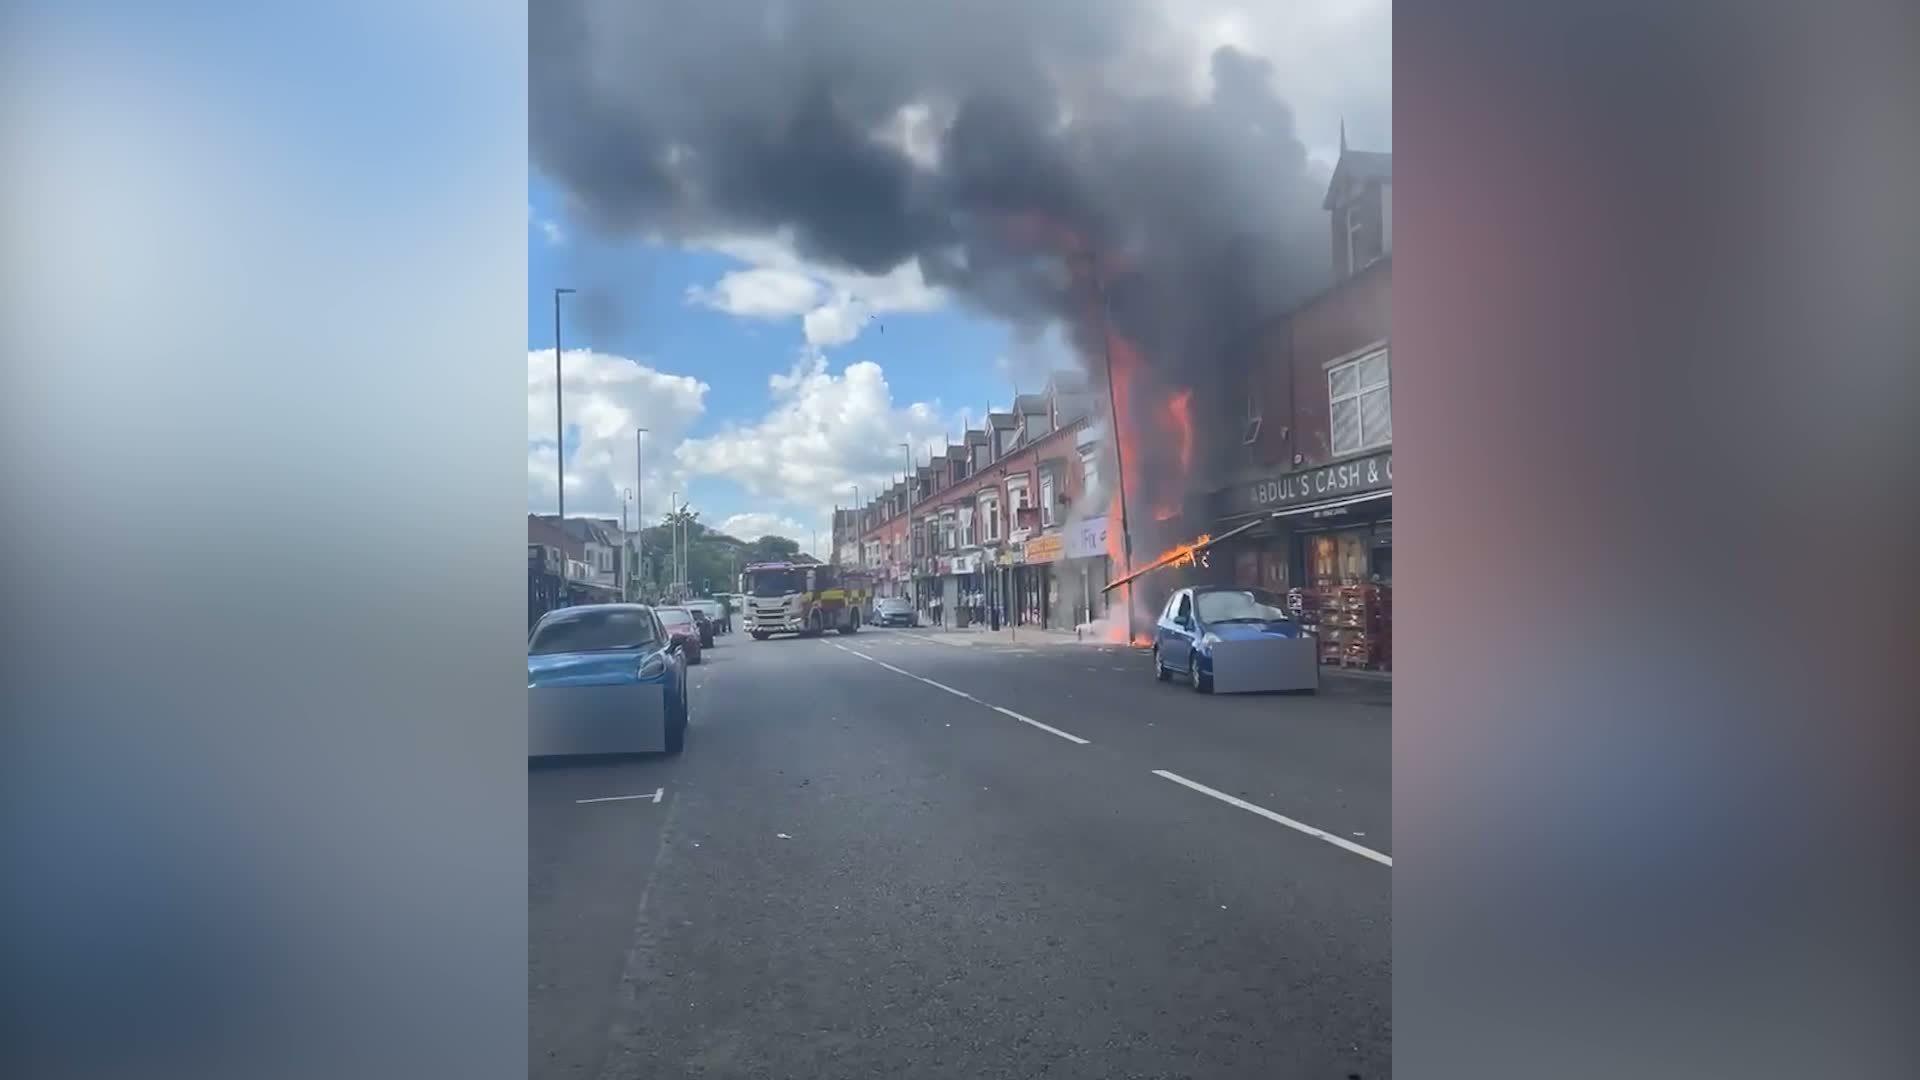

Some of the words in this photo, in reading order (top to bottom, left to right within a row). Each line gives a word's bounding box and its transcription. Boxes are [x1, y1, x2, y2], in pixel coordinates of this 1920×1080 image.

[1250, 474, 1310, 504] ABDUL'S
[1315, 463, 1360, 493] CASH
[1367, 459, 1379, 484] &
